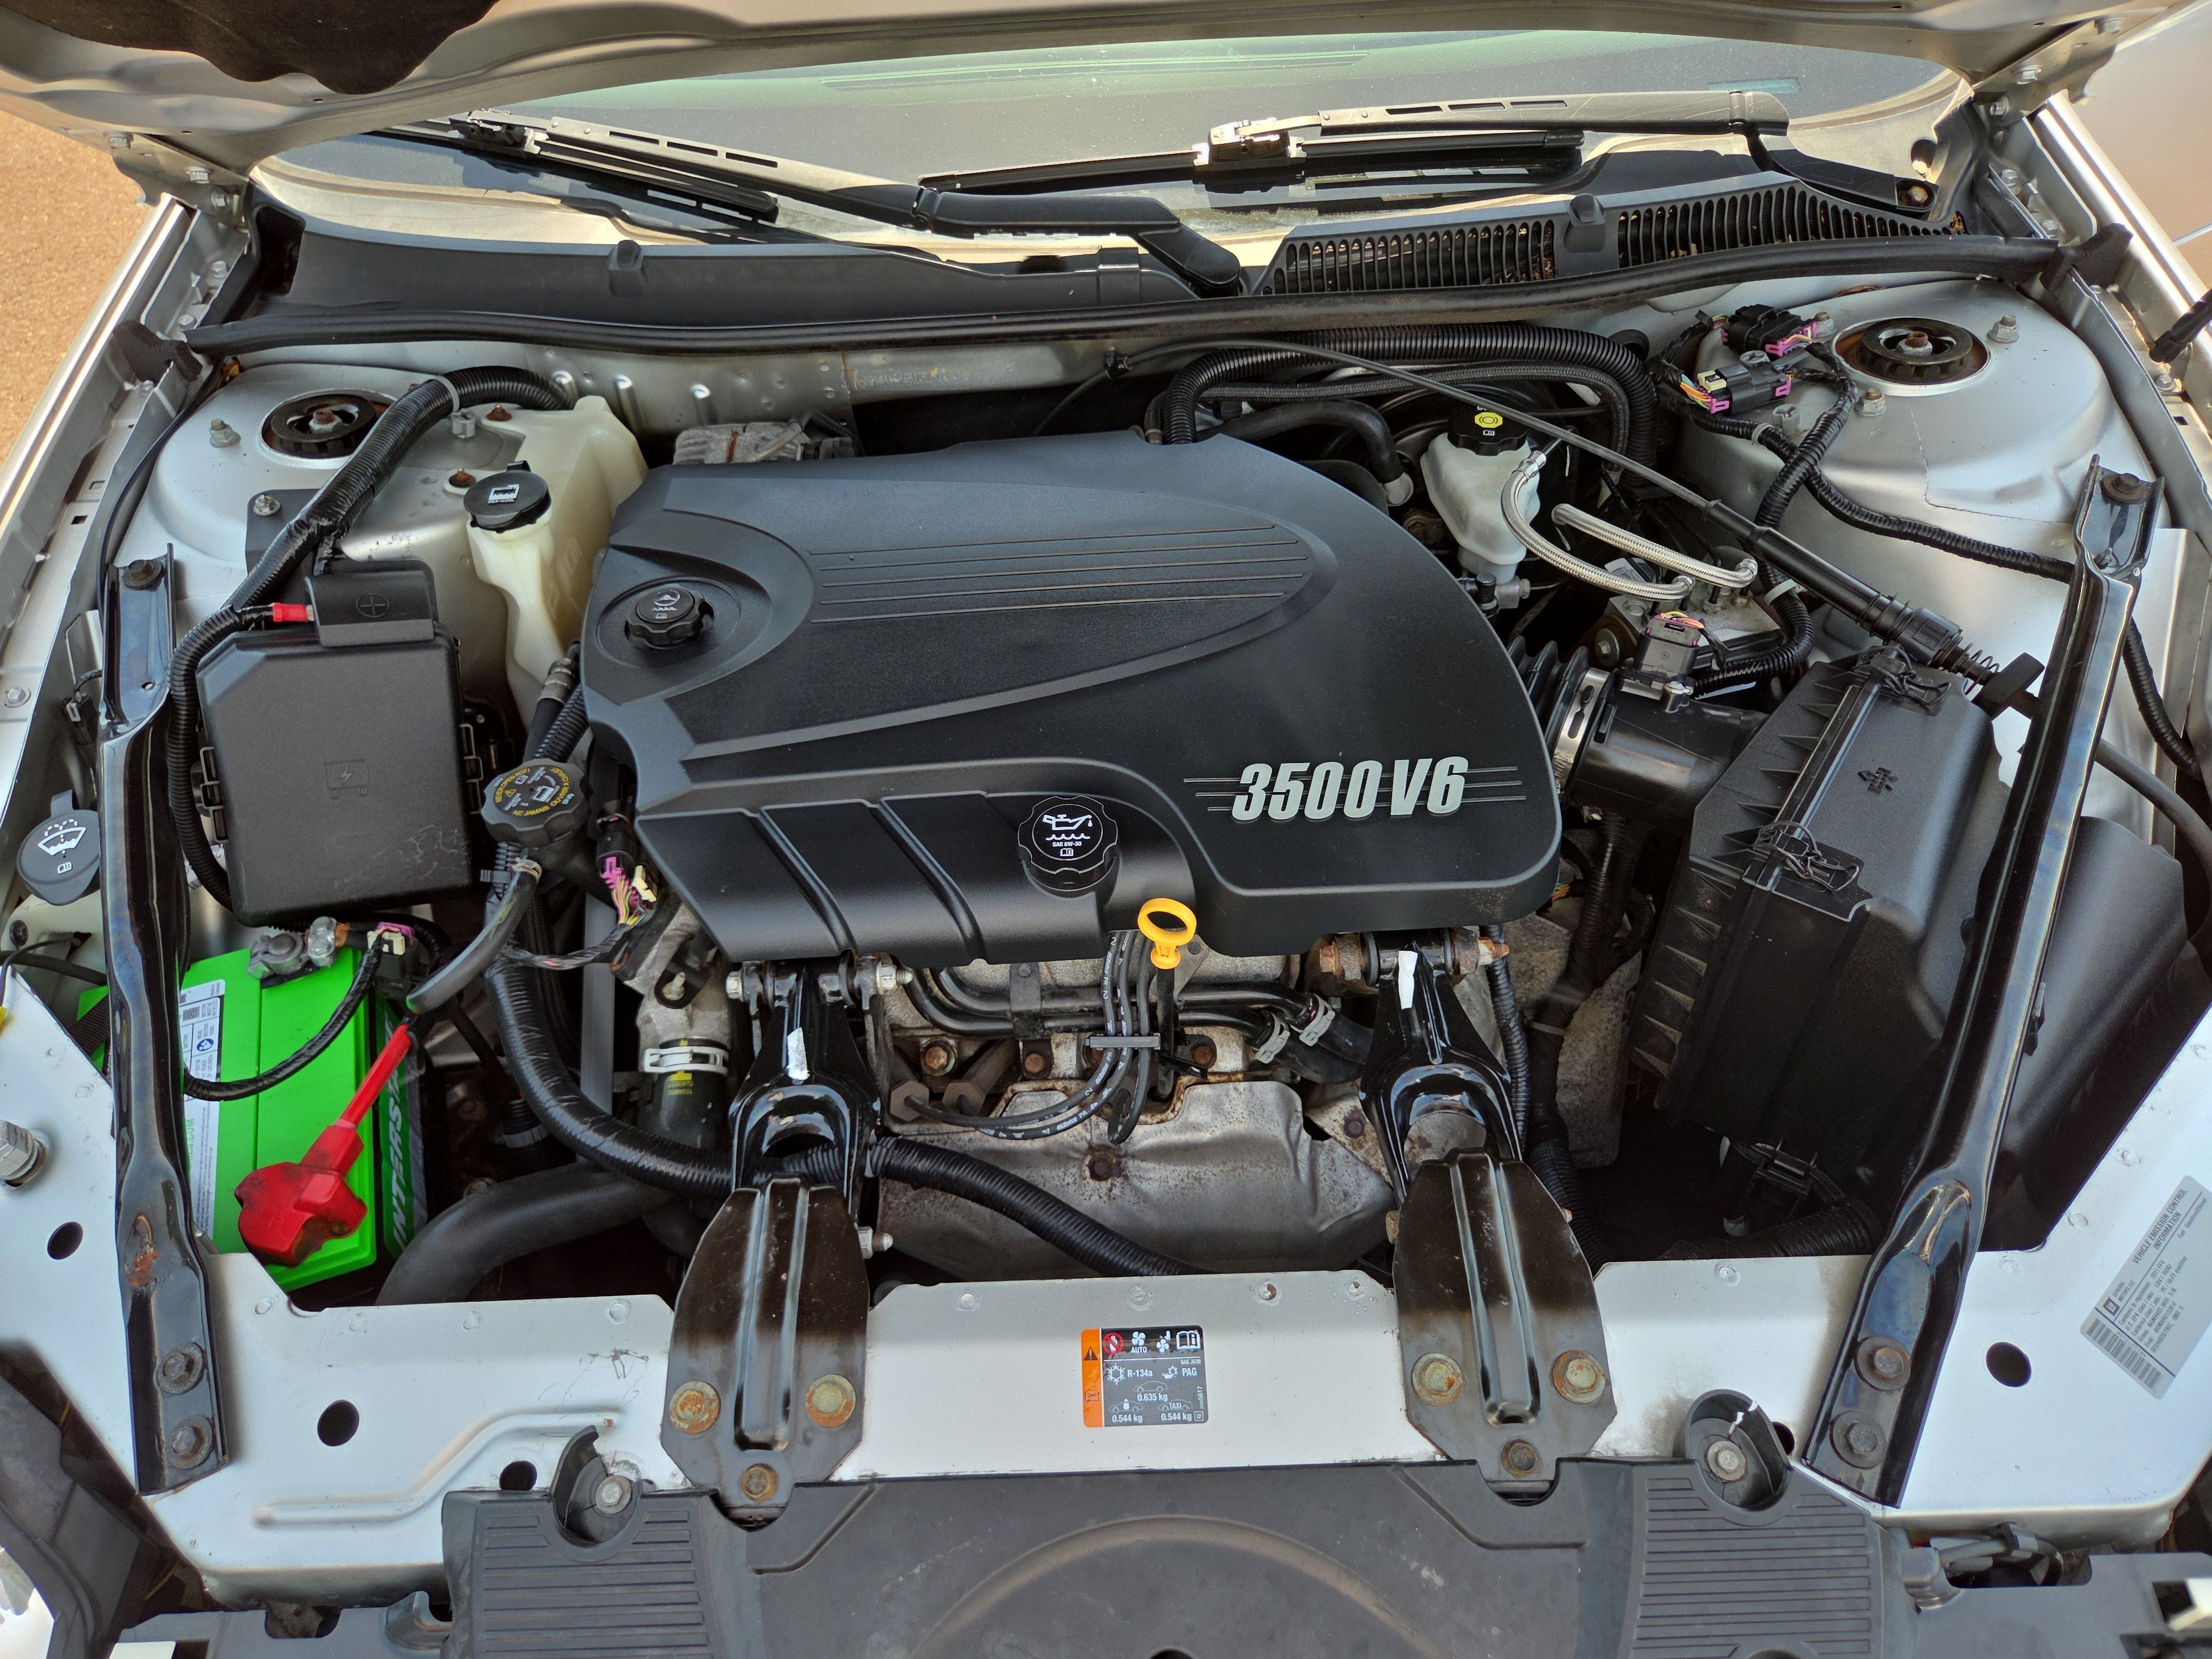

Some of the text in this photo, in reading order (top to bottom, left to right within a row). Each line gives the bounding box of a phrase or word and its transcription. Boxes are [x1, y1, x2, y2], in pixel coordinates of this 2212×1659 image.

[1232, 756, 1468, 821] 3500 V6
[1111, 936, 1116, 946] 2
[1103, 990, 1108, 1000] 2
[1085, 1087, 1094, 1096] 2
[2132, 1187, 2187, 1264] VEHICLE EMISSION CONTROL
[2152, 1211, 2182, 1250] INFORMATION
[1127, 1369, 1153, 1377] R-134a
[1182, 1368, 1197, 1376] PAG
[1137, 1393, 1168, 1402] 0.635 kg
[1112, 1414, 1143, 1423] 0.544 kg
[1161, 1413, 1181, 1421] 0.544
[1182, 1412, 1192, 1422] kg
